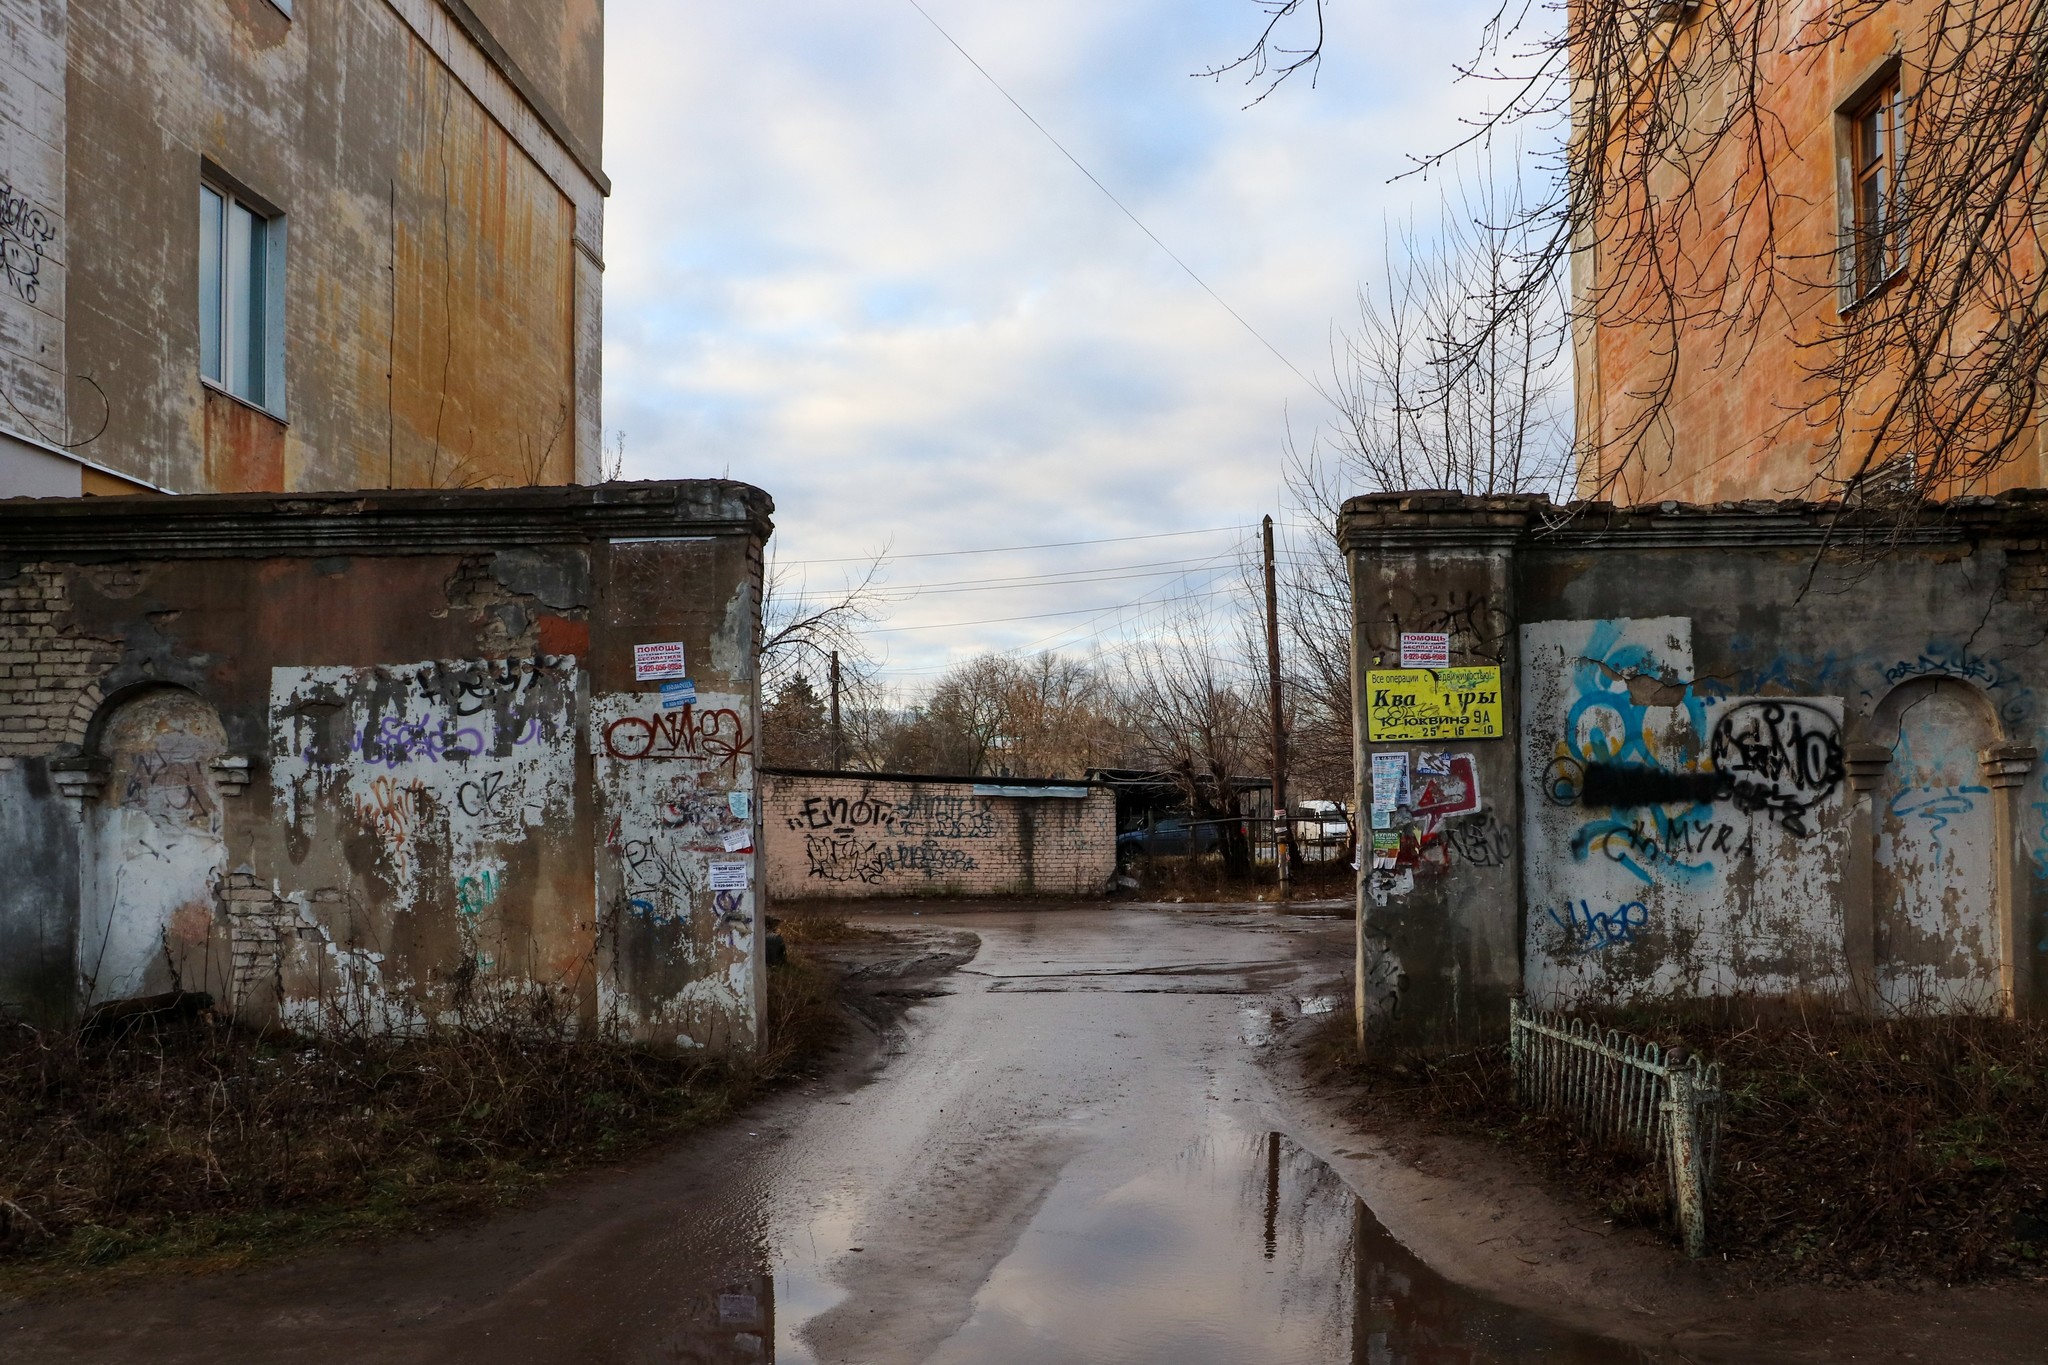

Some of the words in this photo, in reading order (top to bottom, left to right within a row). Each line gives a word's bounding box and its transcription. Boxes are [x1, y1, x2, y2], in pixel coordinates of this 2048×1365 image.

[637, 644, 681, 653] ПОМОЩЬ
[1372, 674, 1385, 684] Все
[1385, 673, 1419, 685] операции
[1423, 674, 1428, 683] с
